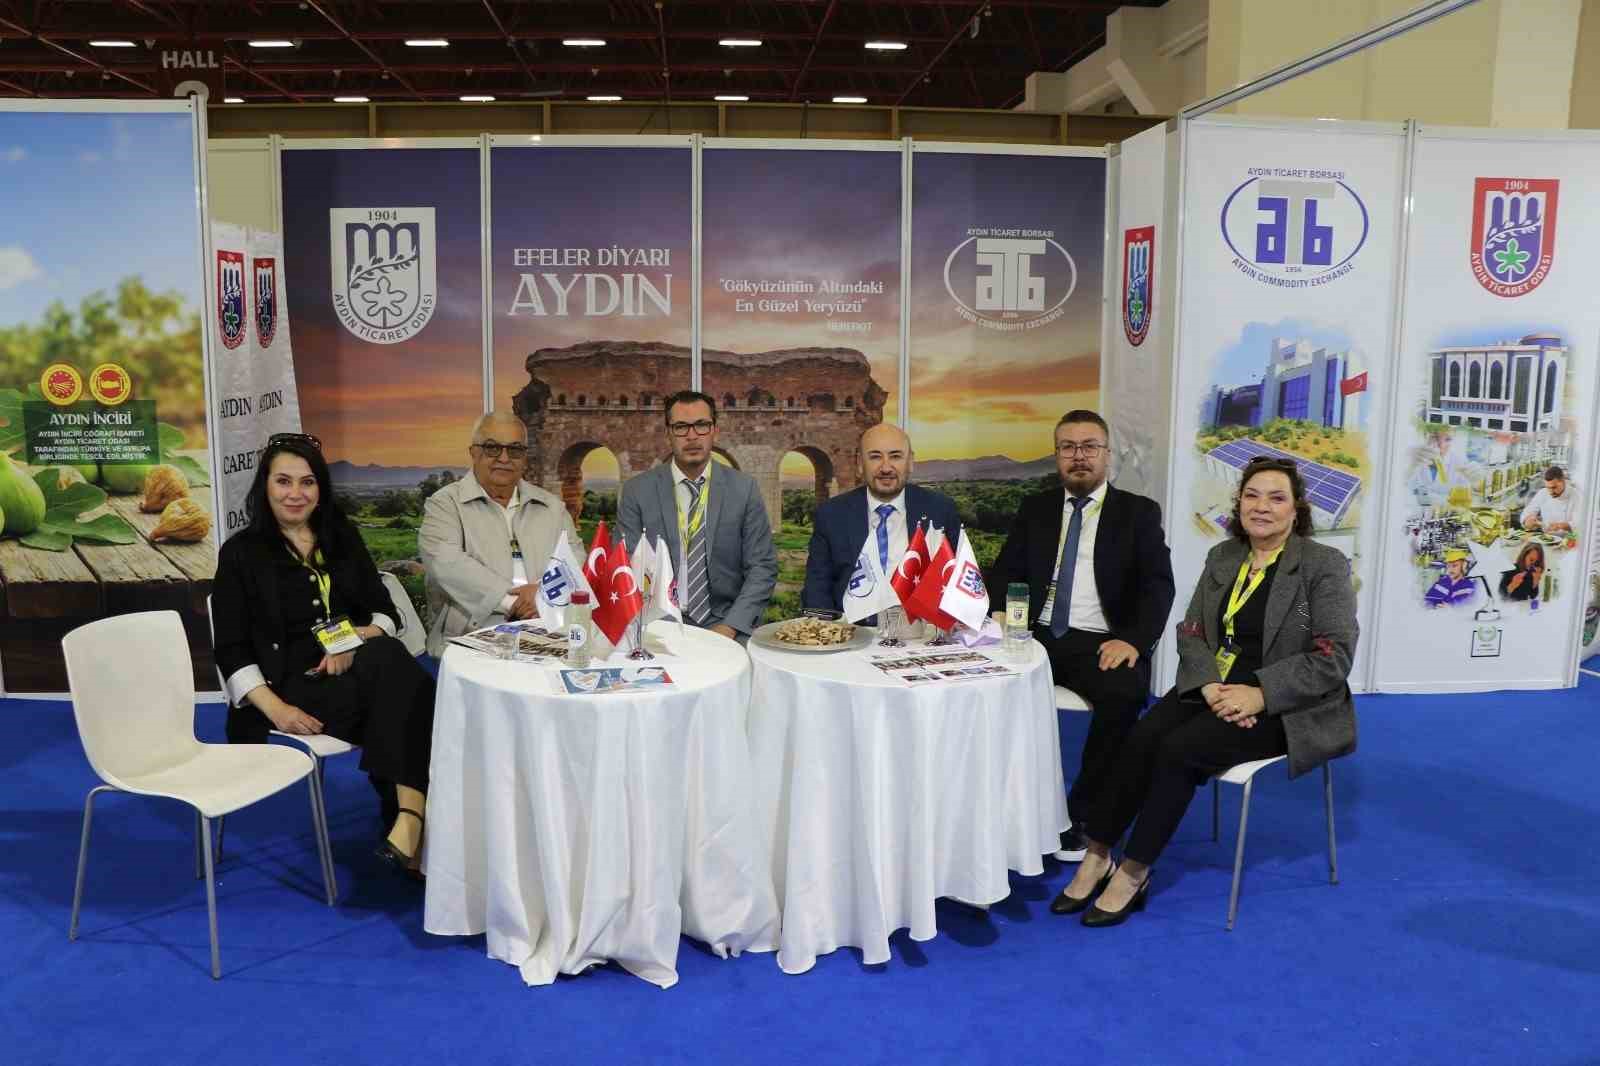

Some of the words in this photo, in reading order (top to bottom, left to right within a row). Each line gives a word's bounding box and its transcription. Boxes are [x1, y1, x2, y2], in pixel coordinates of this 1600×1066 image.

[162, 50, 219, 69] HALL
[1248, 167, 1273, 176] AYDIN
[1309, 170, 1345, 180] BORSASI
[368, 210, 398, 221] 1904
[513, 248, 591, 266] EFELER
[598, 244, 670, 266] DİYARI
[1231, 257, 1259, 278] AYDIN
[1257, 273, 1309, 289] COMMODITY
[1311, 263, 1354, 287] EXCHANGE
[1472, 253, 1488, 283] AYDIN
[507, 273, 672, 316] AYDIN
[817, 280, 884, 295] Altındaki
[334, 293, 359, 329] AYDIN
[411, 293, 433, 329] ODASI
[735, 299, 754, 312] En
[758, 298, 800, 312] Güzel
[220, 396, 253, 418] AYDIN
[50, 412, 90, 425] AYDIN
[93, 410, 132, 425] İNCİRİ
